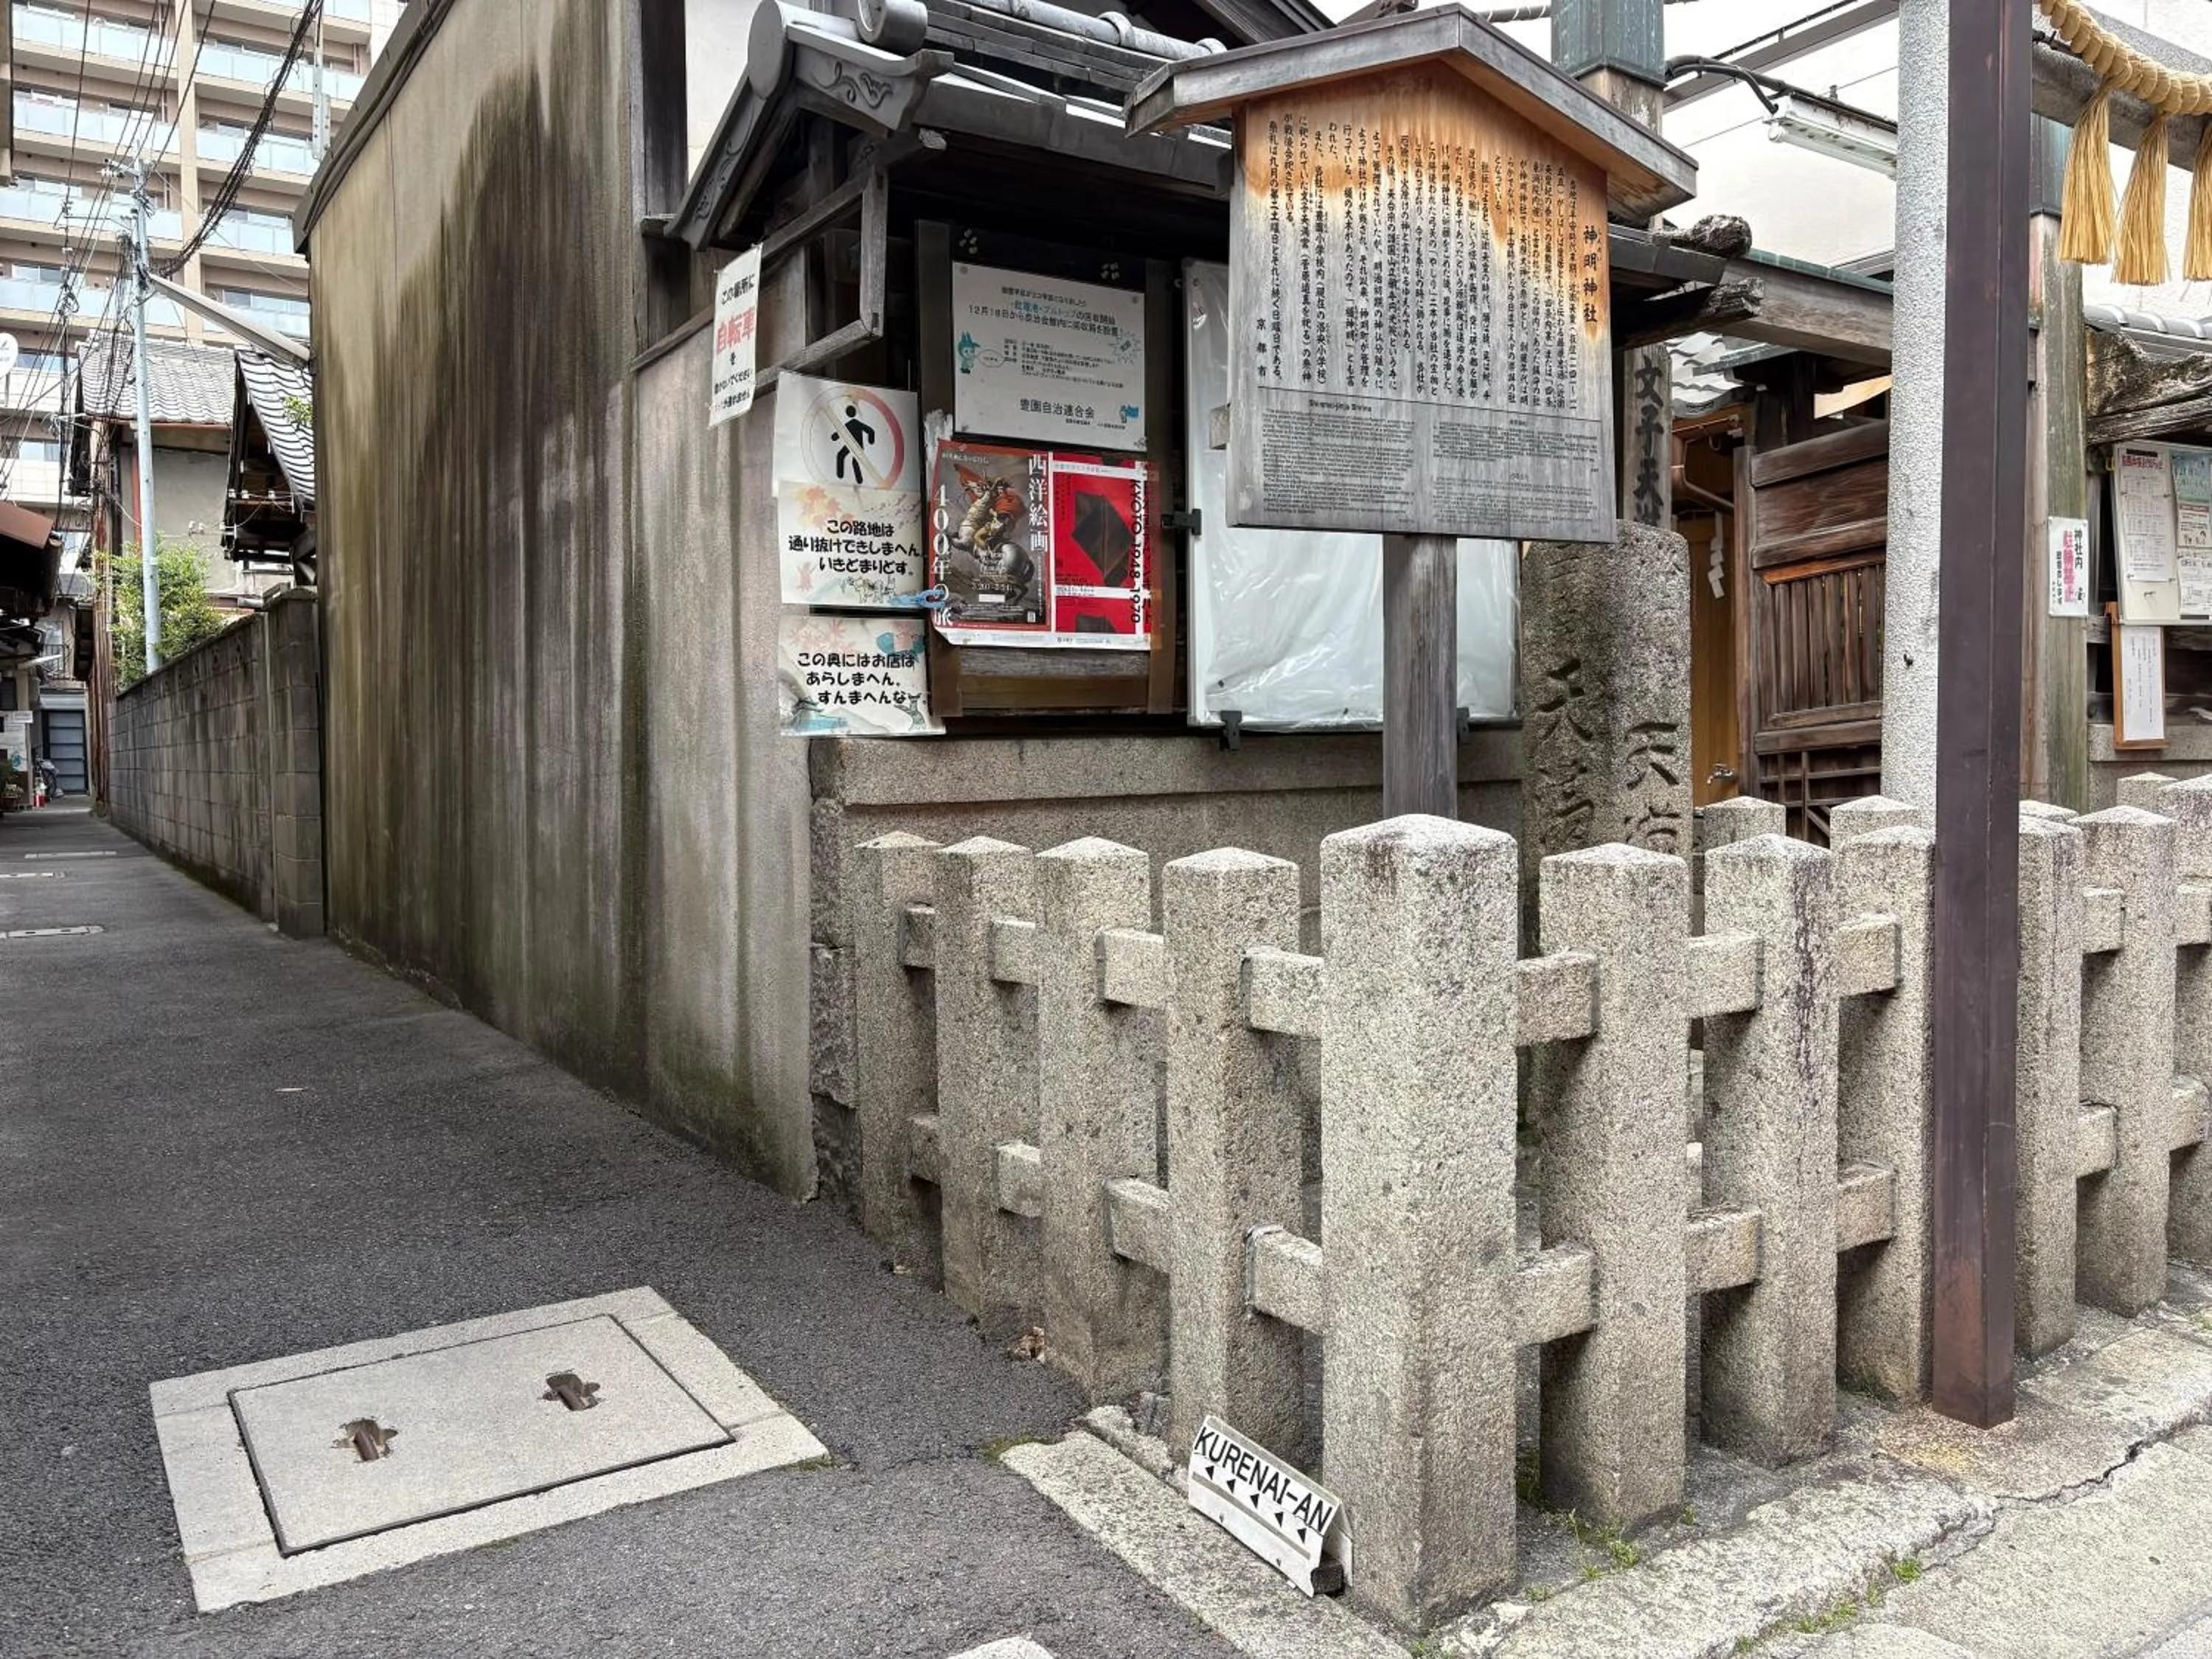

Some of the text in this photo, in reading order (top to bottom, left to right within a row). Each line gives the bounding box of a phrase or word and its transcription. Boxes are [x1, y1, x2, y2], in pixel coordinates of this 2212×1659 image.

[1583, 225, 1598, 323] 神明神社
[717, 307, 755, 355] 自転車
[1256, 317, 1267, 378] 京都市
[827, 519, 894, 538] この路地は
[1029, 453, 1048, 552] 西洋絵画
[1130, 479, 1141, 535] KYOTO
[818, 557, 914, 577] いきどまりどす。
[797, 653, 915, 669] この奥にはお店は
[806, 672, 901, 687] あらしまへん。
[1194, 1426, 1333, 1533] KURENAI-AN
